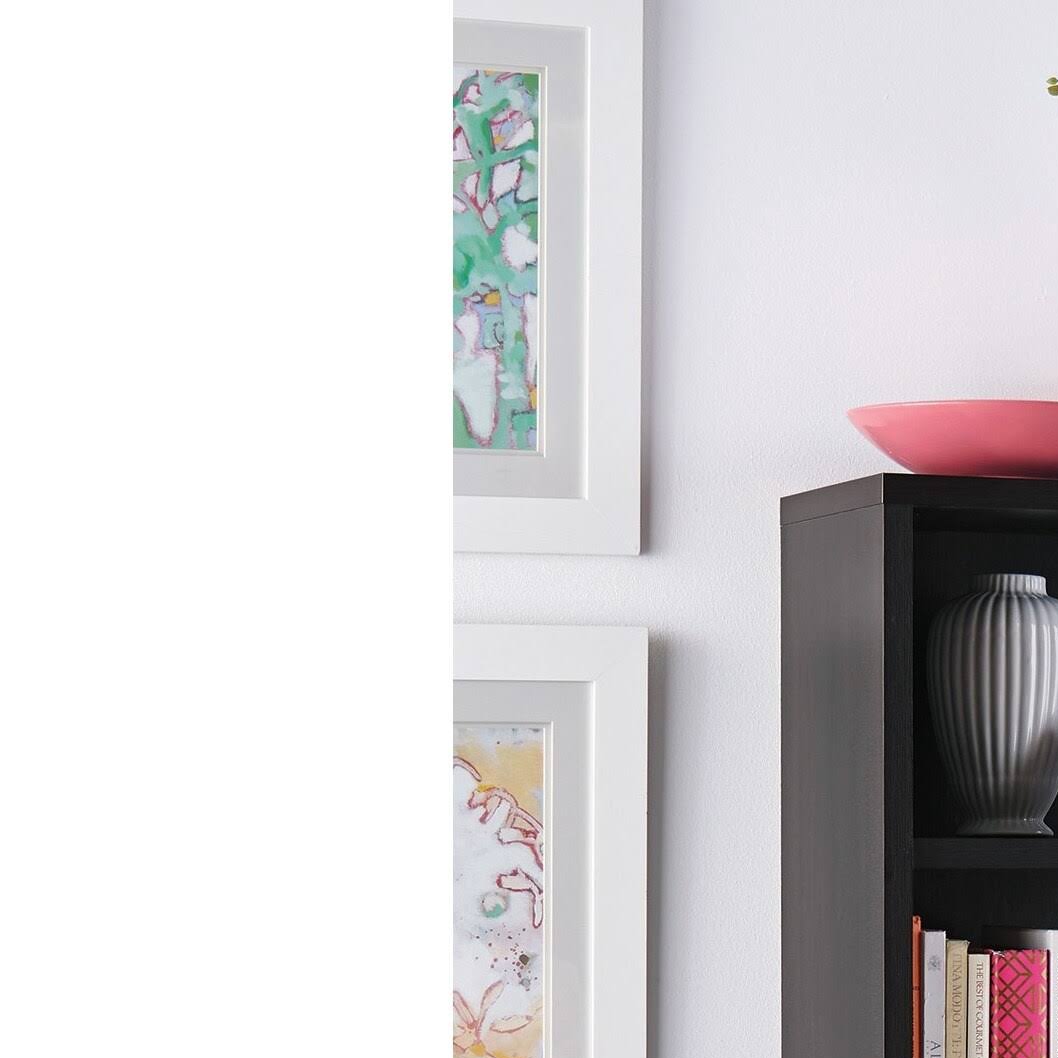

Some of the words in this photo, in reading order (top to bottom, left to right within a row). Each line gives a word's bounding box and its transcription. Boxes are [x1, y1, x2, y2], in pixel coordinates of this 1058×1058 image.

[976, 962, 984, 979] THE
[975, 980, 984, 998] BEST
[975, 999, 984, 1010] OF
[975, 1011, 984, 1056] GOURMET
